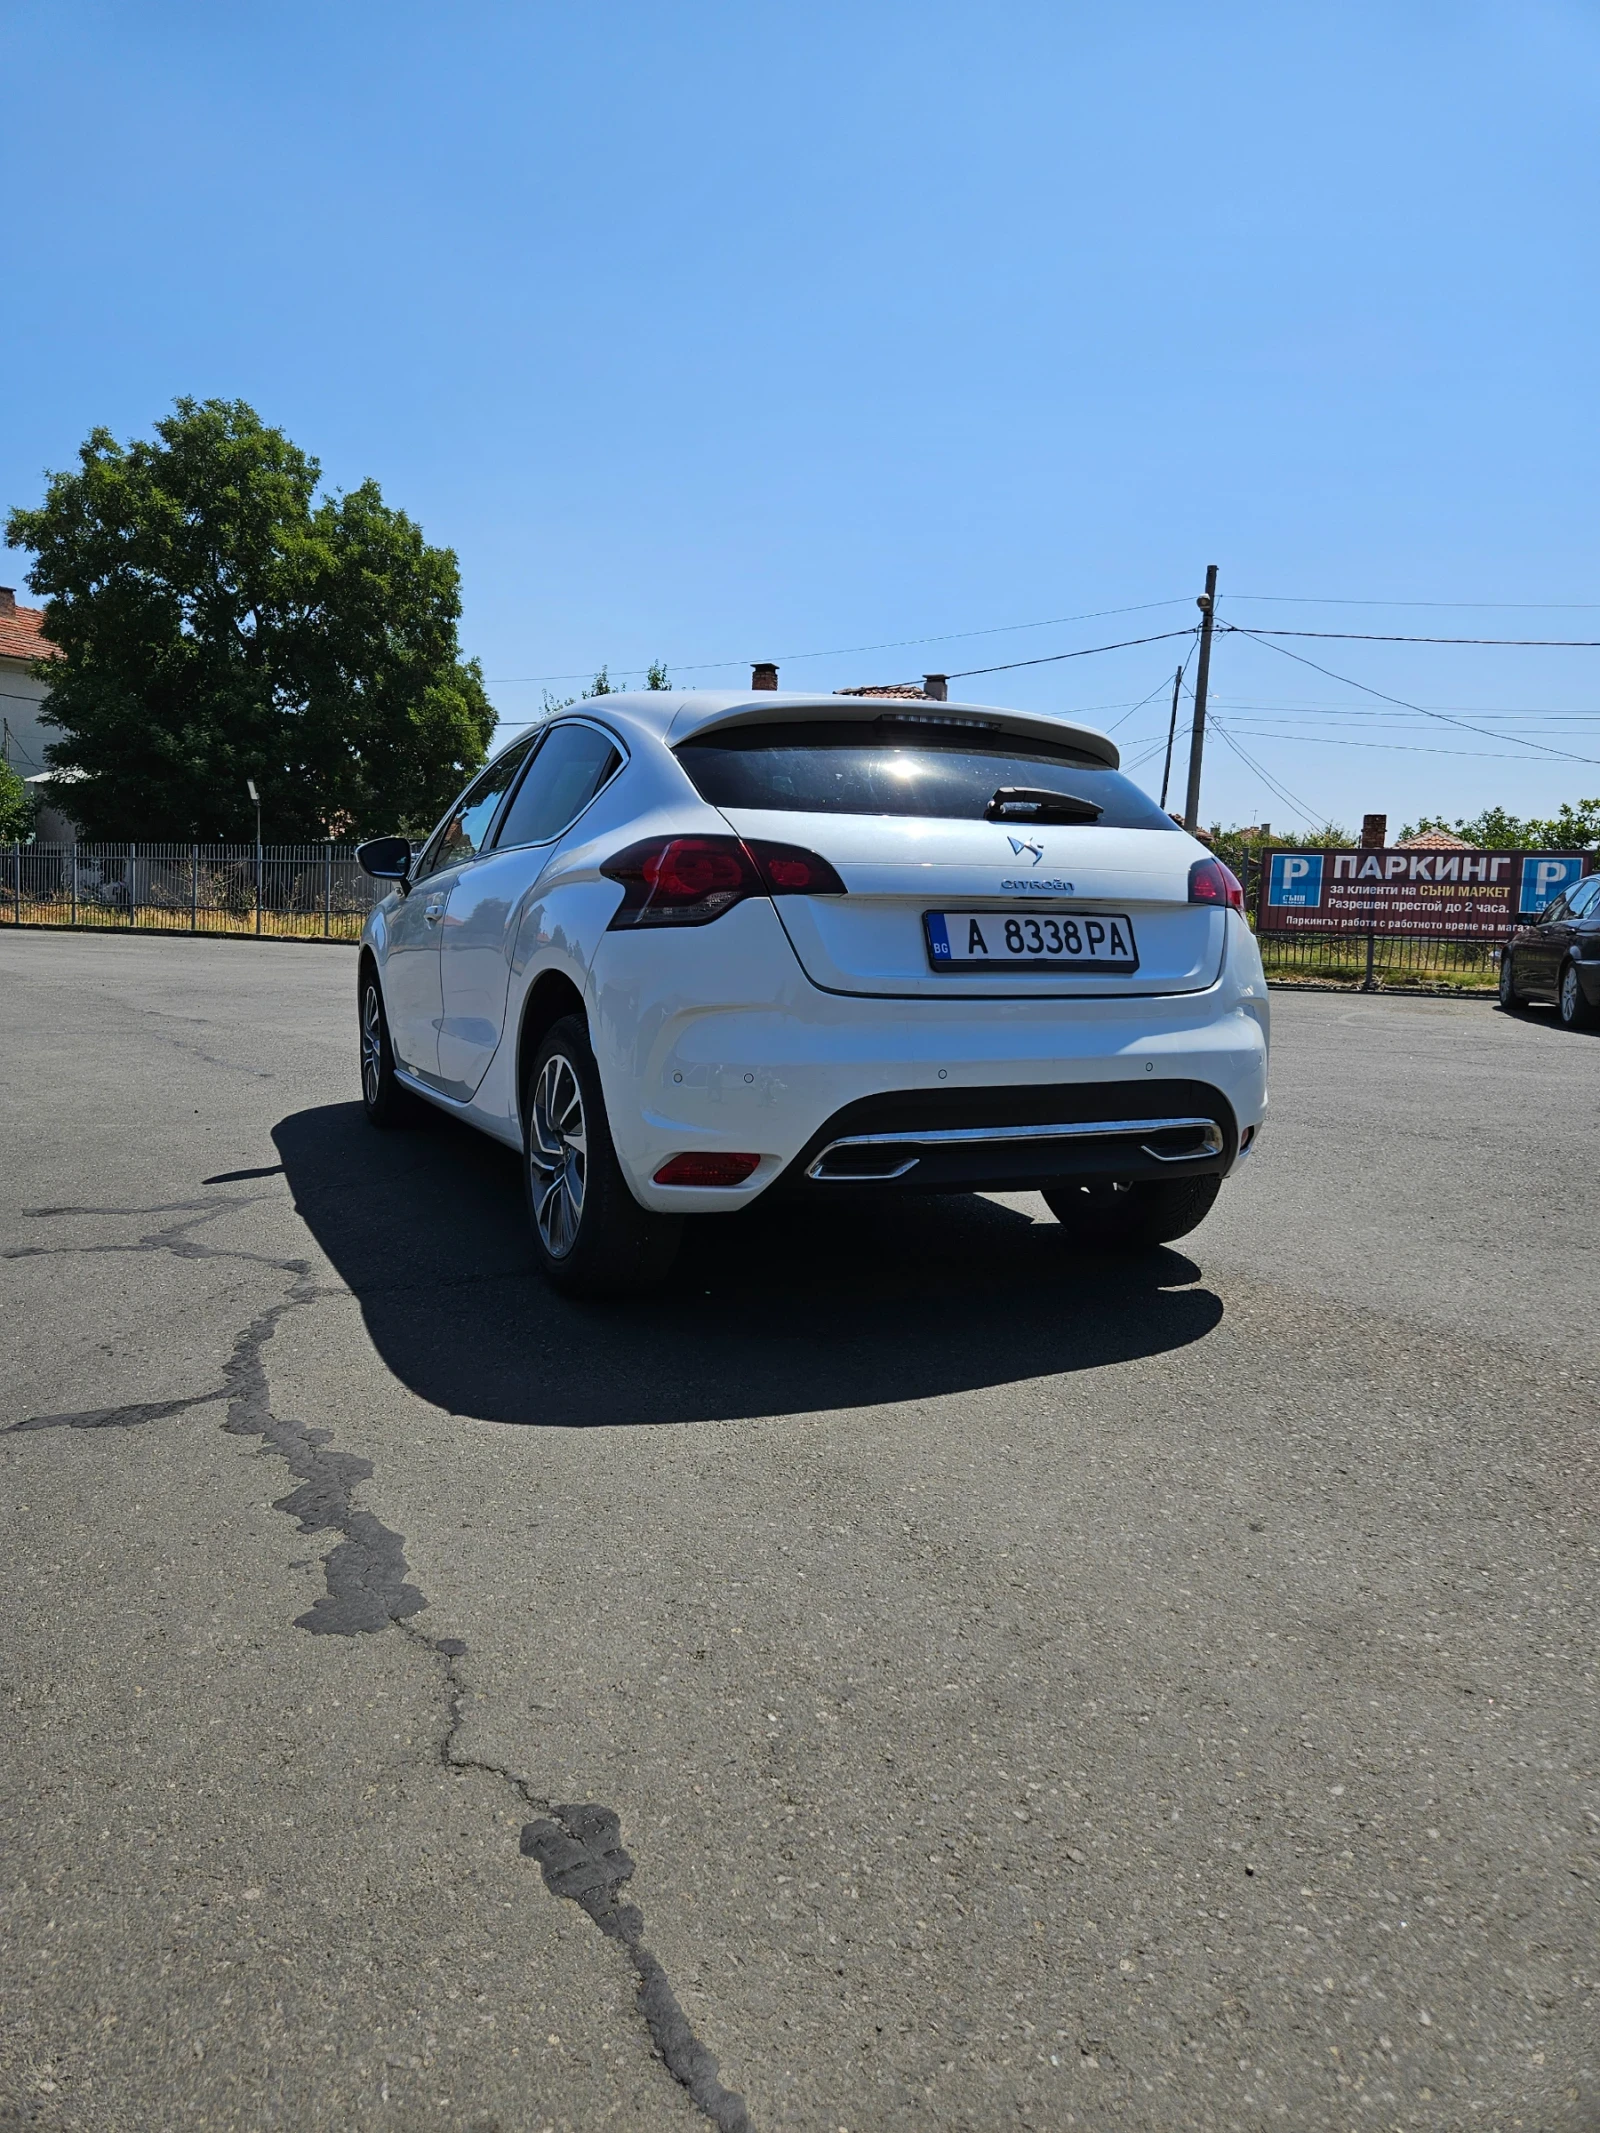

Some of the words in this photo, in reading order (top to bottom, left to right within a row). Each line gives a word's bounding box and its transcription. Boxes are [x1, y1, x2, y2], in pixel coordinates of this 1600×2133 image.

[1282, 858, 1309, 889] P
[1333, 855, 1511, 882] ПАРКИНГ
[1535, 862, 1567, 895] P
[1330, 885, 1344, 894] за
[1347, 885, 1398, 895] клиенти
[1401, 886, 1416, 895] на
[1420, 885, 1455, 896] СЪНИ
[1458, 886, 1511, 898] МАРКЕТ
[1328, 898, 1388, 910] Разрешен
[1391, 900, 1442, 912] престой
[1445, 904, 1462, 913] до
[1464, 902, 1473, 912] 2
[1476, 904, 1510, 913] часа.
[1286, 915, 1339, 925] Паркингът
[1341, 917, 1377, 927] работи
[1388, 919, 1442, 929] работното
[1445, 921, 1478, 931] време
[1481, 923, 1494, 931] на
[933, 943, 949, 954] BG
